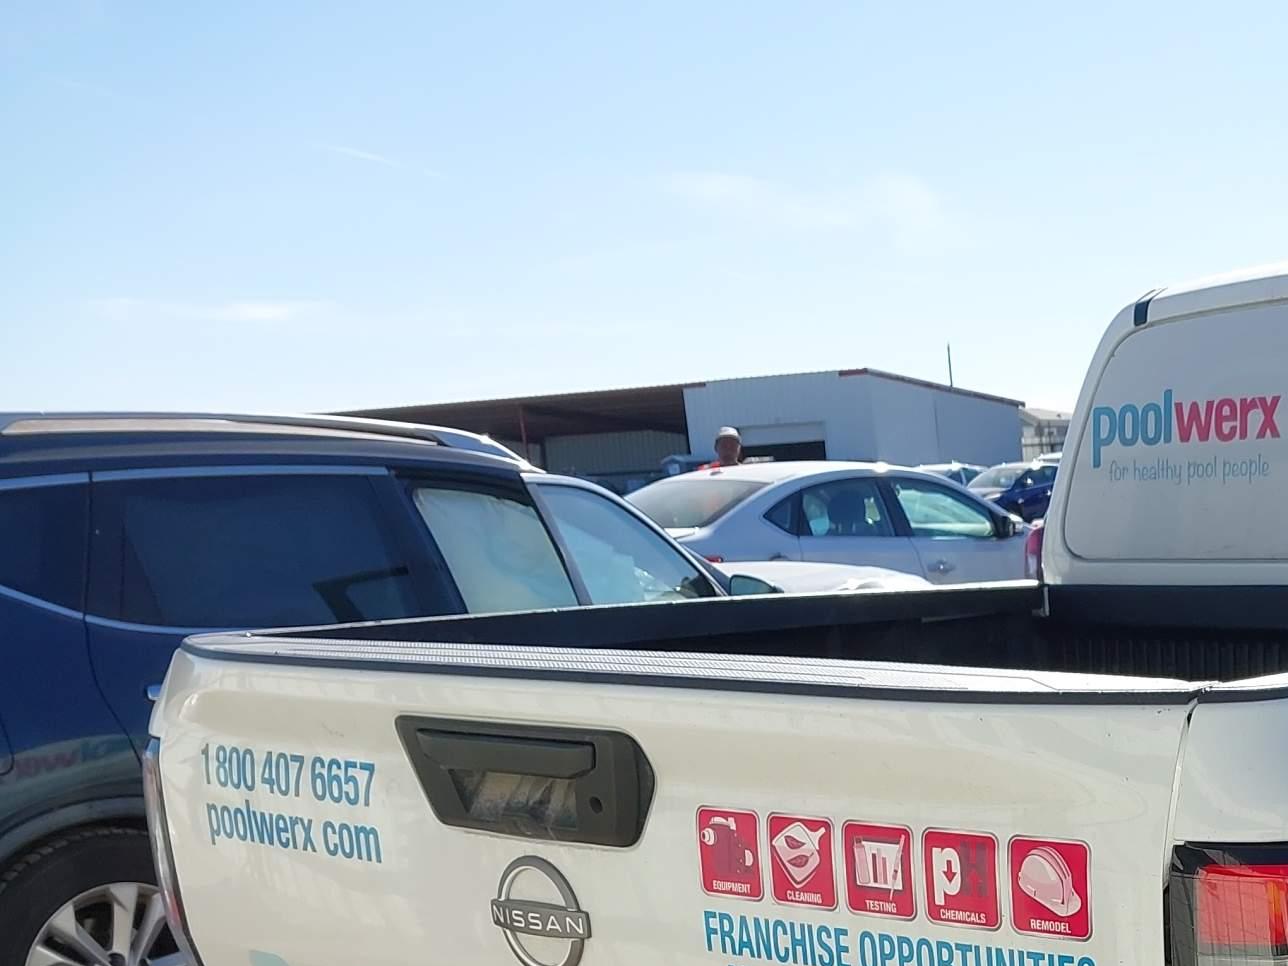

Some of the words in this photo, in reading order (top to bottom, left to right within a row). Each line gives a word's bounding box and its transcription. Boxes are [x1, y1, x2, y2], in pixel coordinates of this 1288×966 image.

[1092, 389, 1281, 469] poolwerx
[1109, 459, 1129, 482] for
[1133, 456, 1182, 486] healthy
[1187, 456, 1217, 485] pool
[1222, 453, 1270, 484] people
[201, 743, 211, 785] 1
[215, 744, 256, 792] 800
[261, 751, 305, 797] 407
[310, 756, 375, 807] 6657
[206, 799, 317, 853] poolwerx
[322, 820, 382, 864] com
[712, 879, 752, 895] EQUIPMENT
[786, 889, 823, 905] CLEANING
[865, 899, 897, 914] TESTING
[939, 908, 986, 924] CHEMICALS
[493, 904, 584, 935] NISSAN
[1029, 919, 1072, 934] REMODEL
